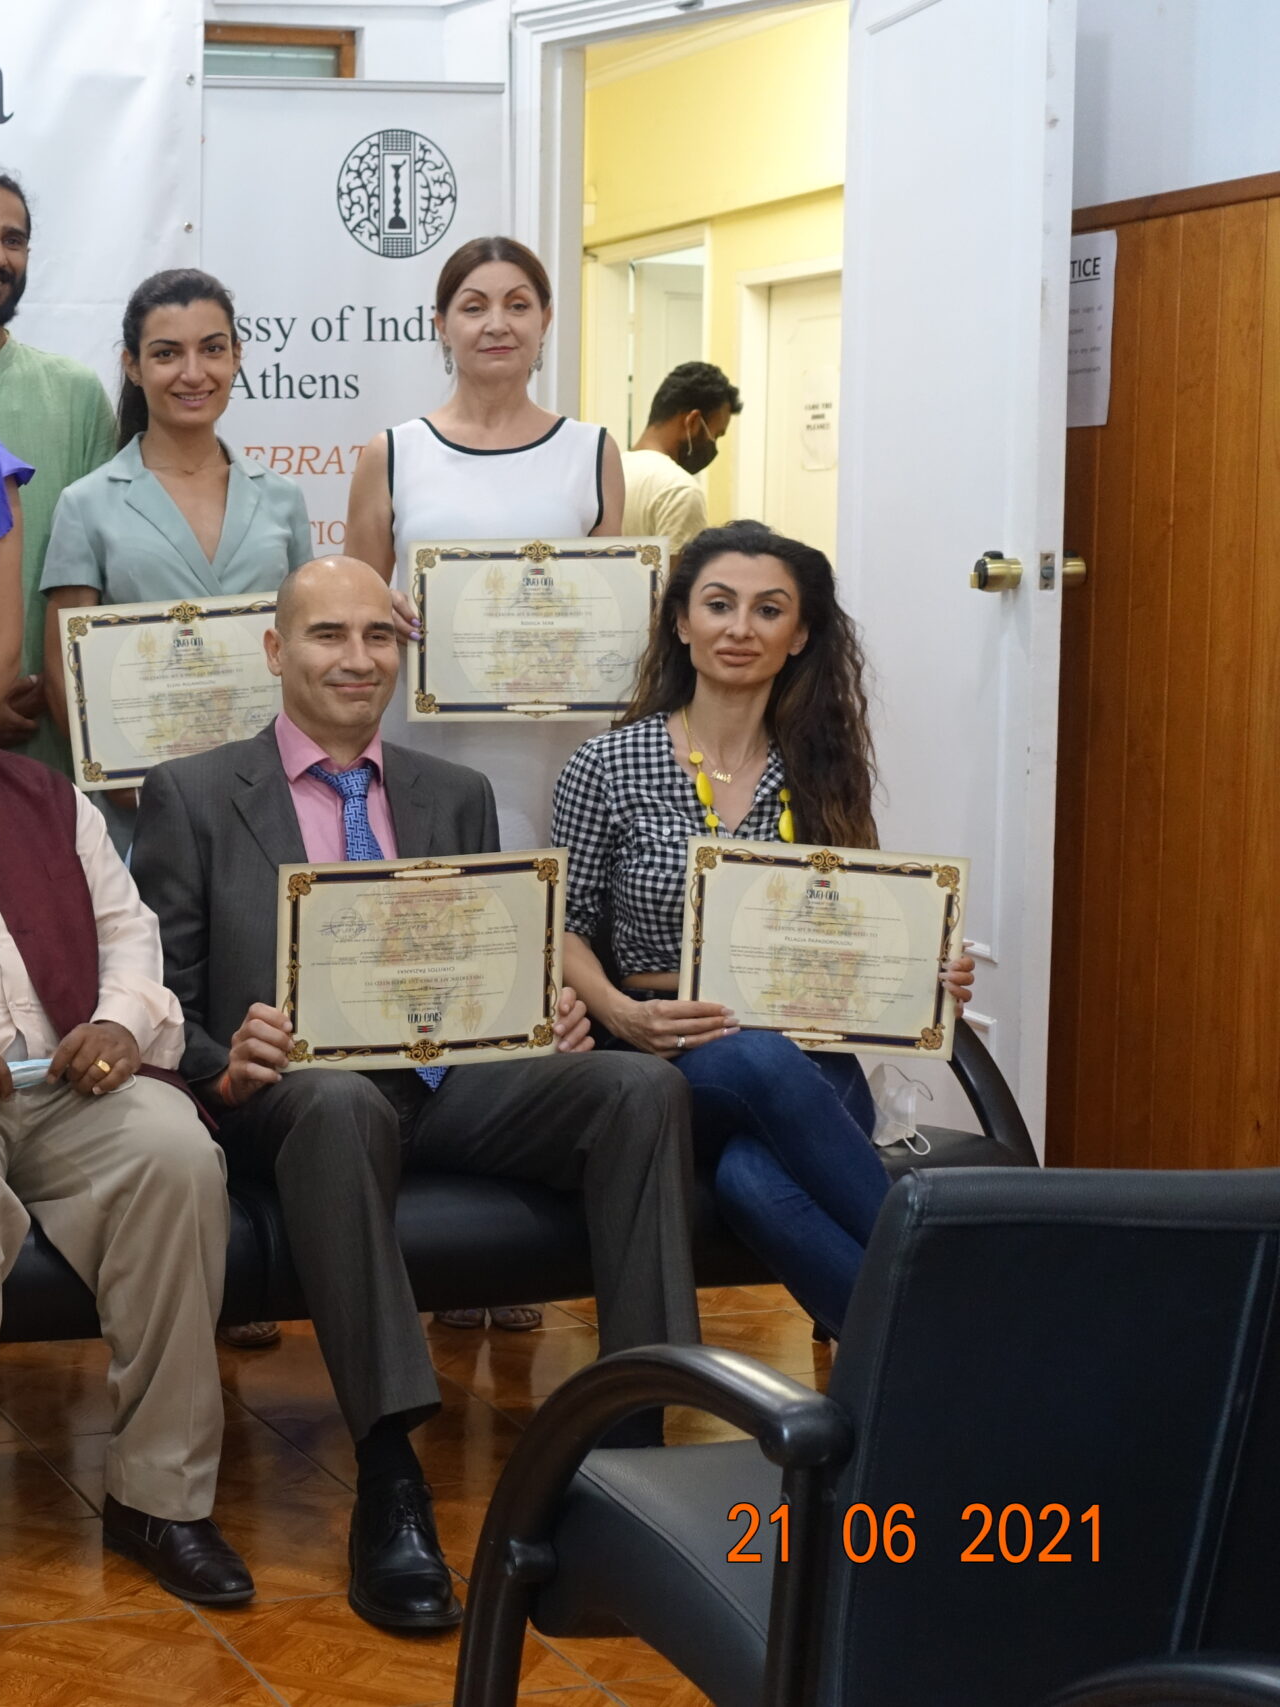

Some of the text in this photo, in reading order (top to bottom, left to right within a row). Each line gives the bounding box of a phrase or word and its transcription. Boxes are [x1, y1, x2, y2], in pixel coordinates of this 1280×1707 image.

[1070, 257, 1102, 280] TICE
[311, 305, 355, 343] of
[363, 305, 438, 343] Indi
[228, 362, 360, 399] Athens
